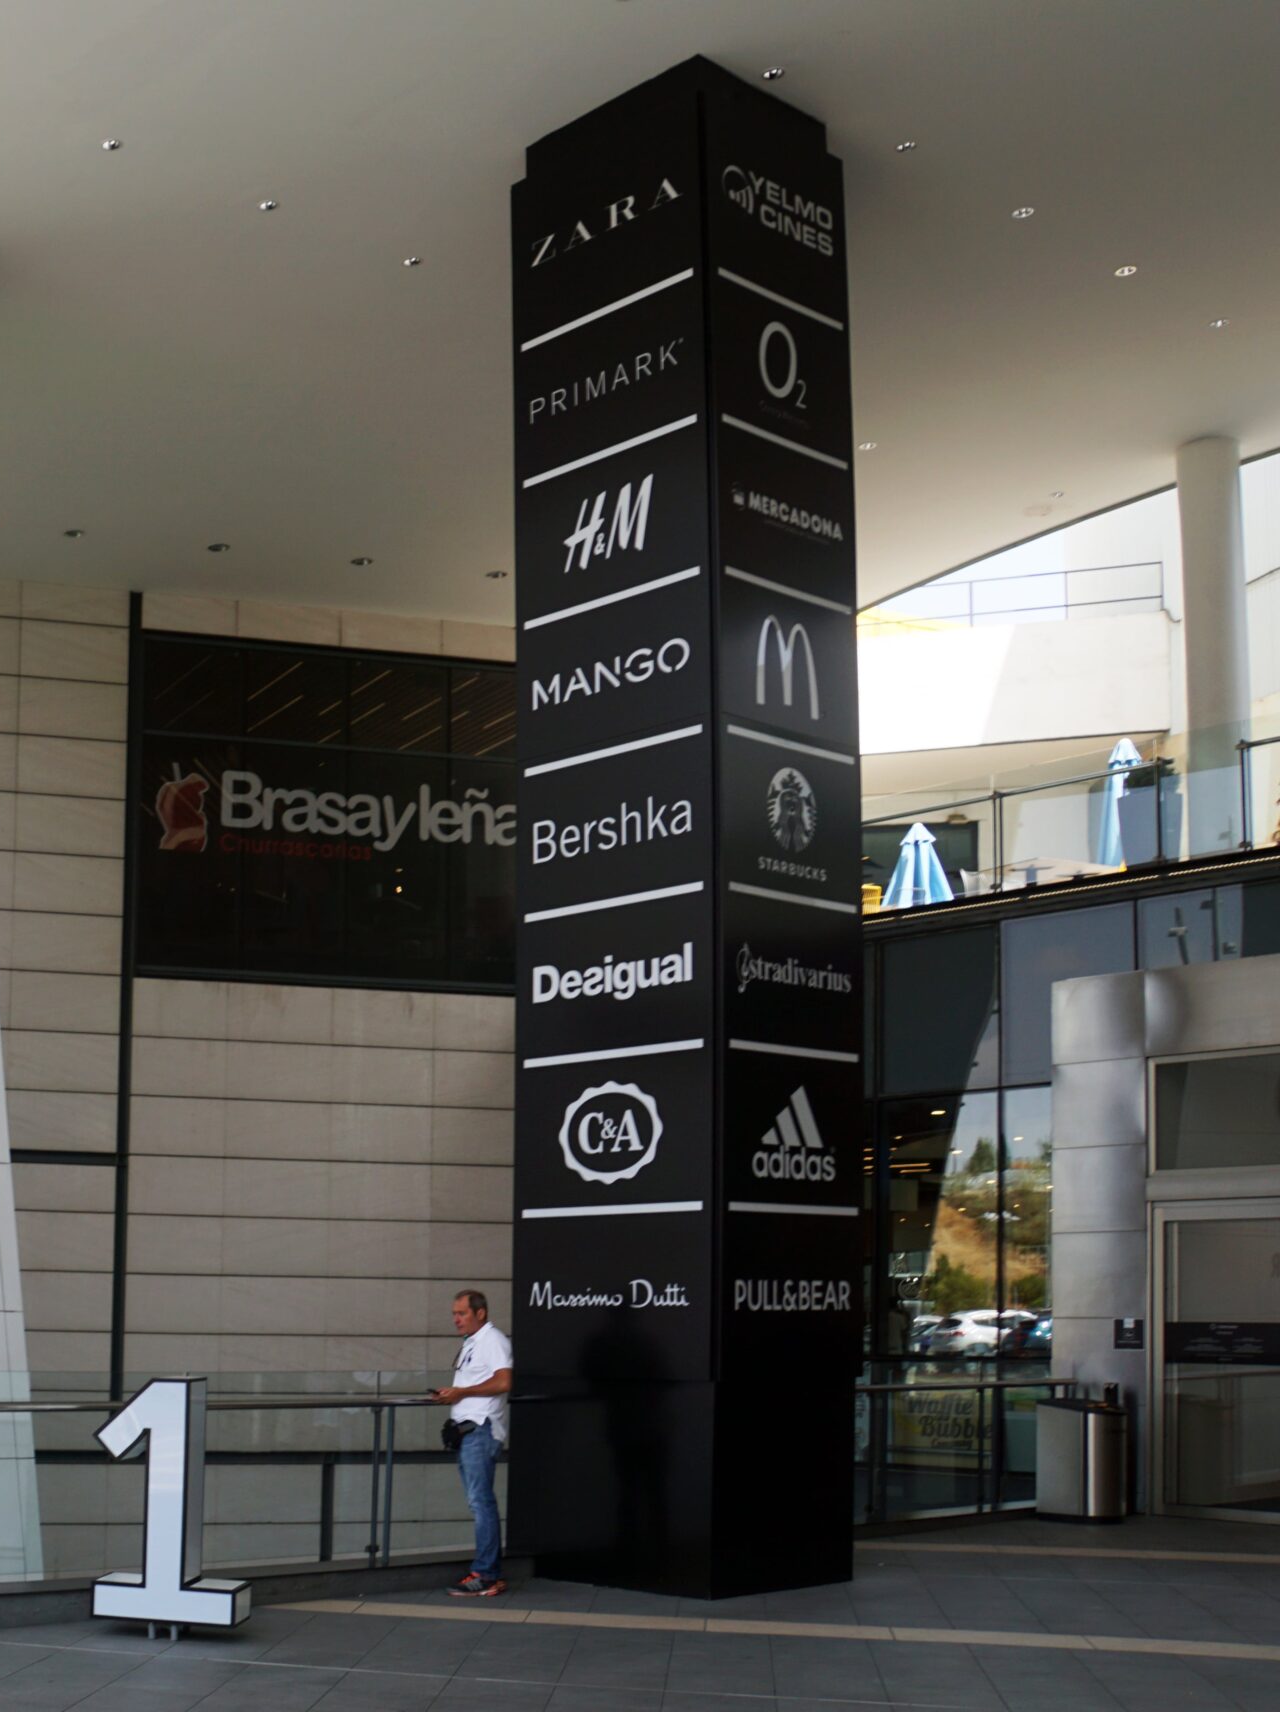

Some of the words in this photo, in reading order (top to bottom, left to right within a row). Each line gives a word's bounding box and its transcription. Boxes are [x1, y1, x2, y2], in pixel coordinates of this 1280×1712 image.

[529, 176, 684, 269] ZARA
[748, 170, 834, 232] YELMO
[759, 203, 834, 257] CINES
[528, 340, 681, 425] PRIMARK
[563, 473, 655, 574] H&M
[748, 490, 844, 542] MERCADONA
[531, 637, 691, 712] MANGO
[531, 795, 694, 865] Bershka
[757, 855, 828, 882] STARBUCKS
[531, 941, 694, 1005] Desigual
[577, 1107, 645, 1156] C&A
[751, 1146, 837, 1182] adidas
[529, 1280, 624, 1311] Massimo
[628, 1278, 691, 1310] Dutti
[733, 1278, 852, 1312] PULL&BEAR
[918, 1415, 993, 1440] Bubbe
[91, 1376, 252, 1628] 1
